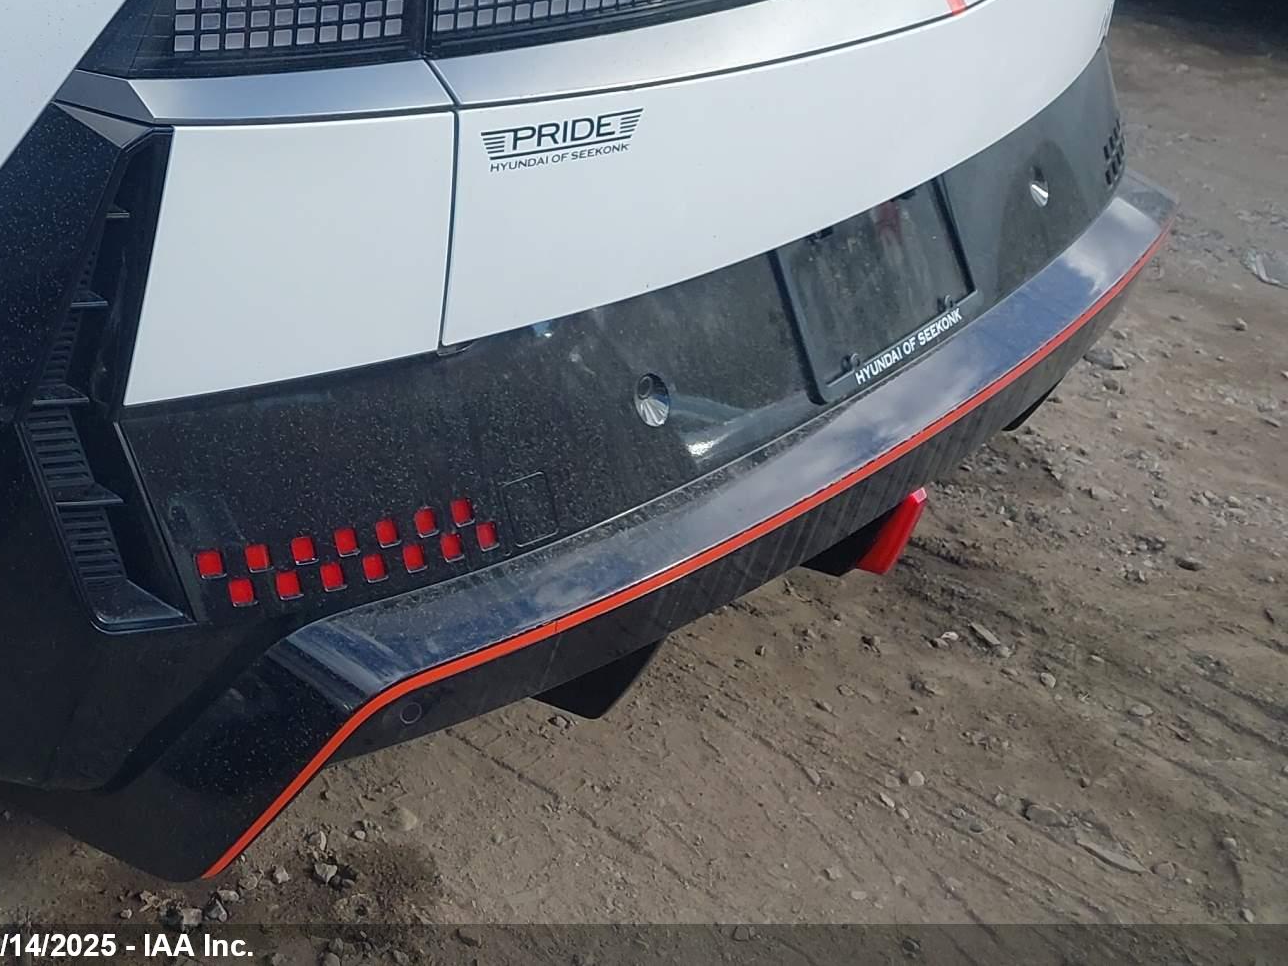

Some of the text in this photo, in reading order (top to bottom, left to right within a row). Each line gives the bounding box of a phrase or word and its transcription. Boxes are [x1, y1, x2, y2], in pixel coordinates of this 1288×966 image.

[512, 115, 615, 150] PRIDE
[489, 143, 629, 172] HYUNDAI OF SEEKONK
[855, 307, 962, 385] HYUNDAI OF SEEKONK
